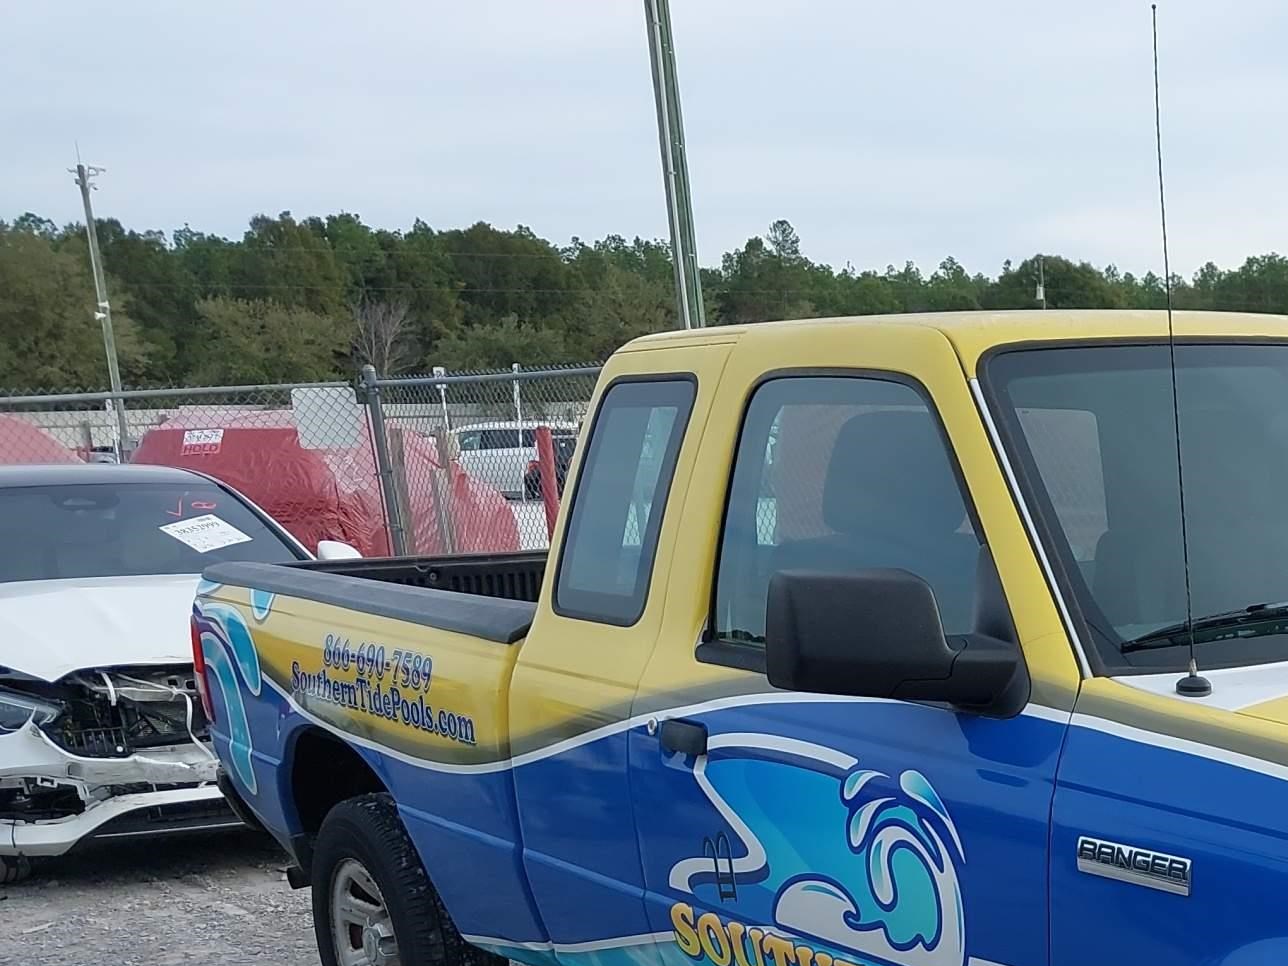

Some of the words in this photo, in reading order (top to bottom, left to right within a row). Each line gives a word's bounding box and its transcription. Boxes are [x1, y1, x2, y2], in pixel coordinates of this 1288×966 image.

[323, 634, 433, 692] 866-690-7589
[292, 661, 477, 746] SouthernTidePools.com
[1079, 839, 1189, 881] RANGER
